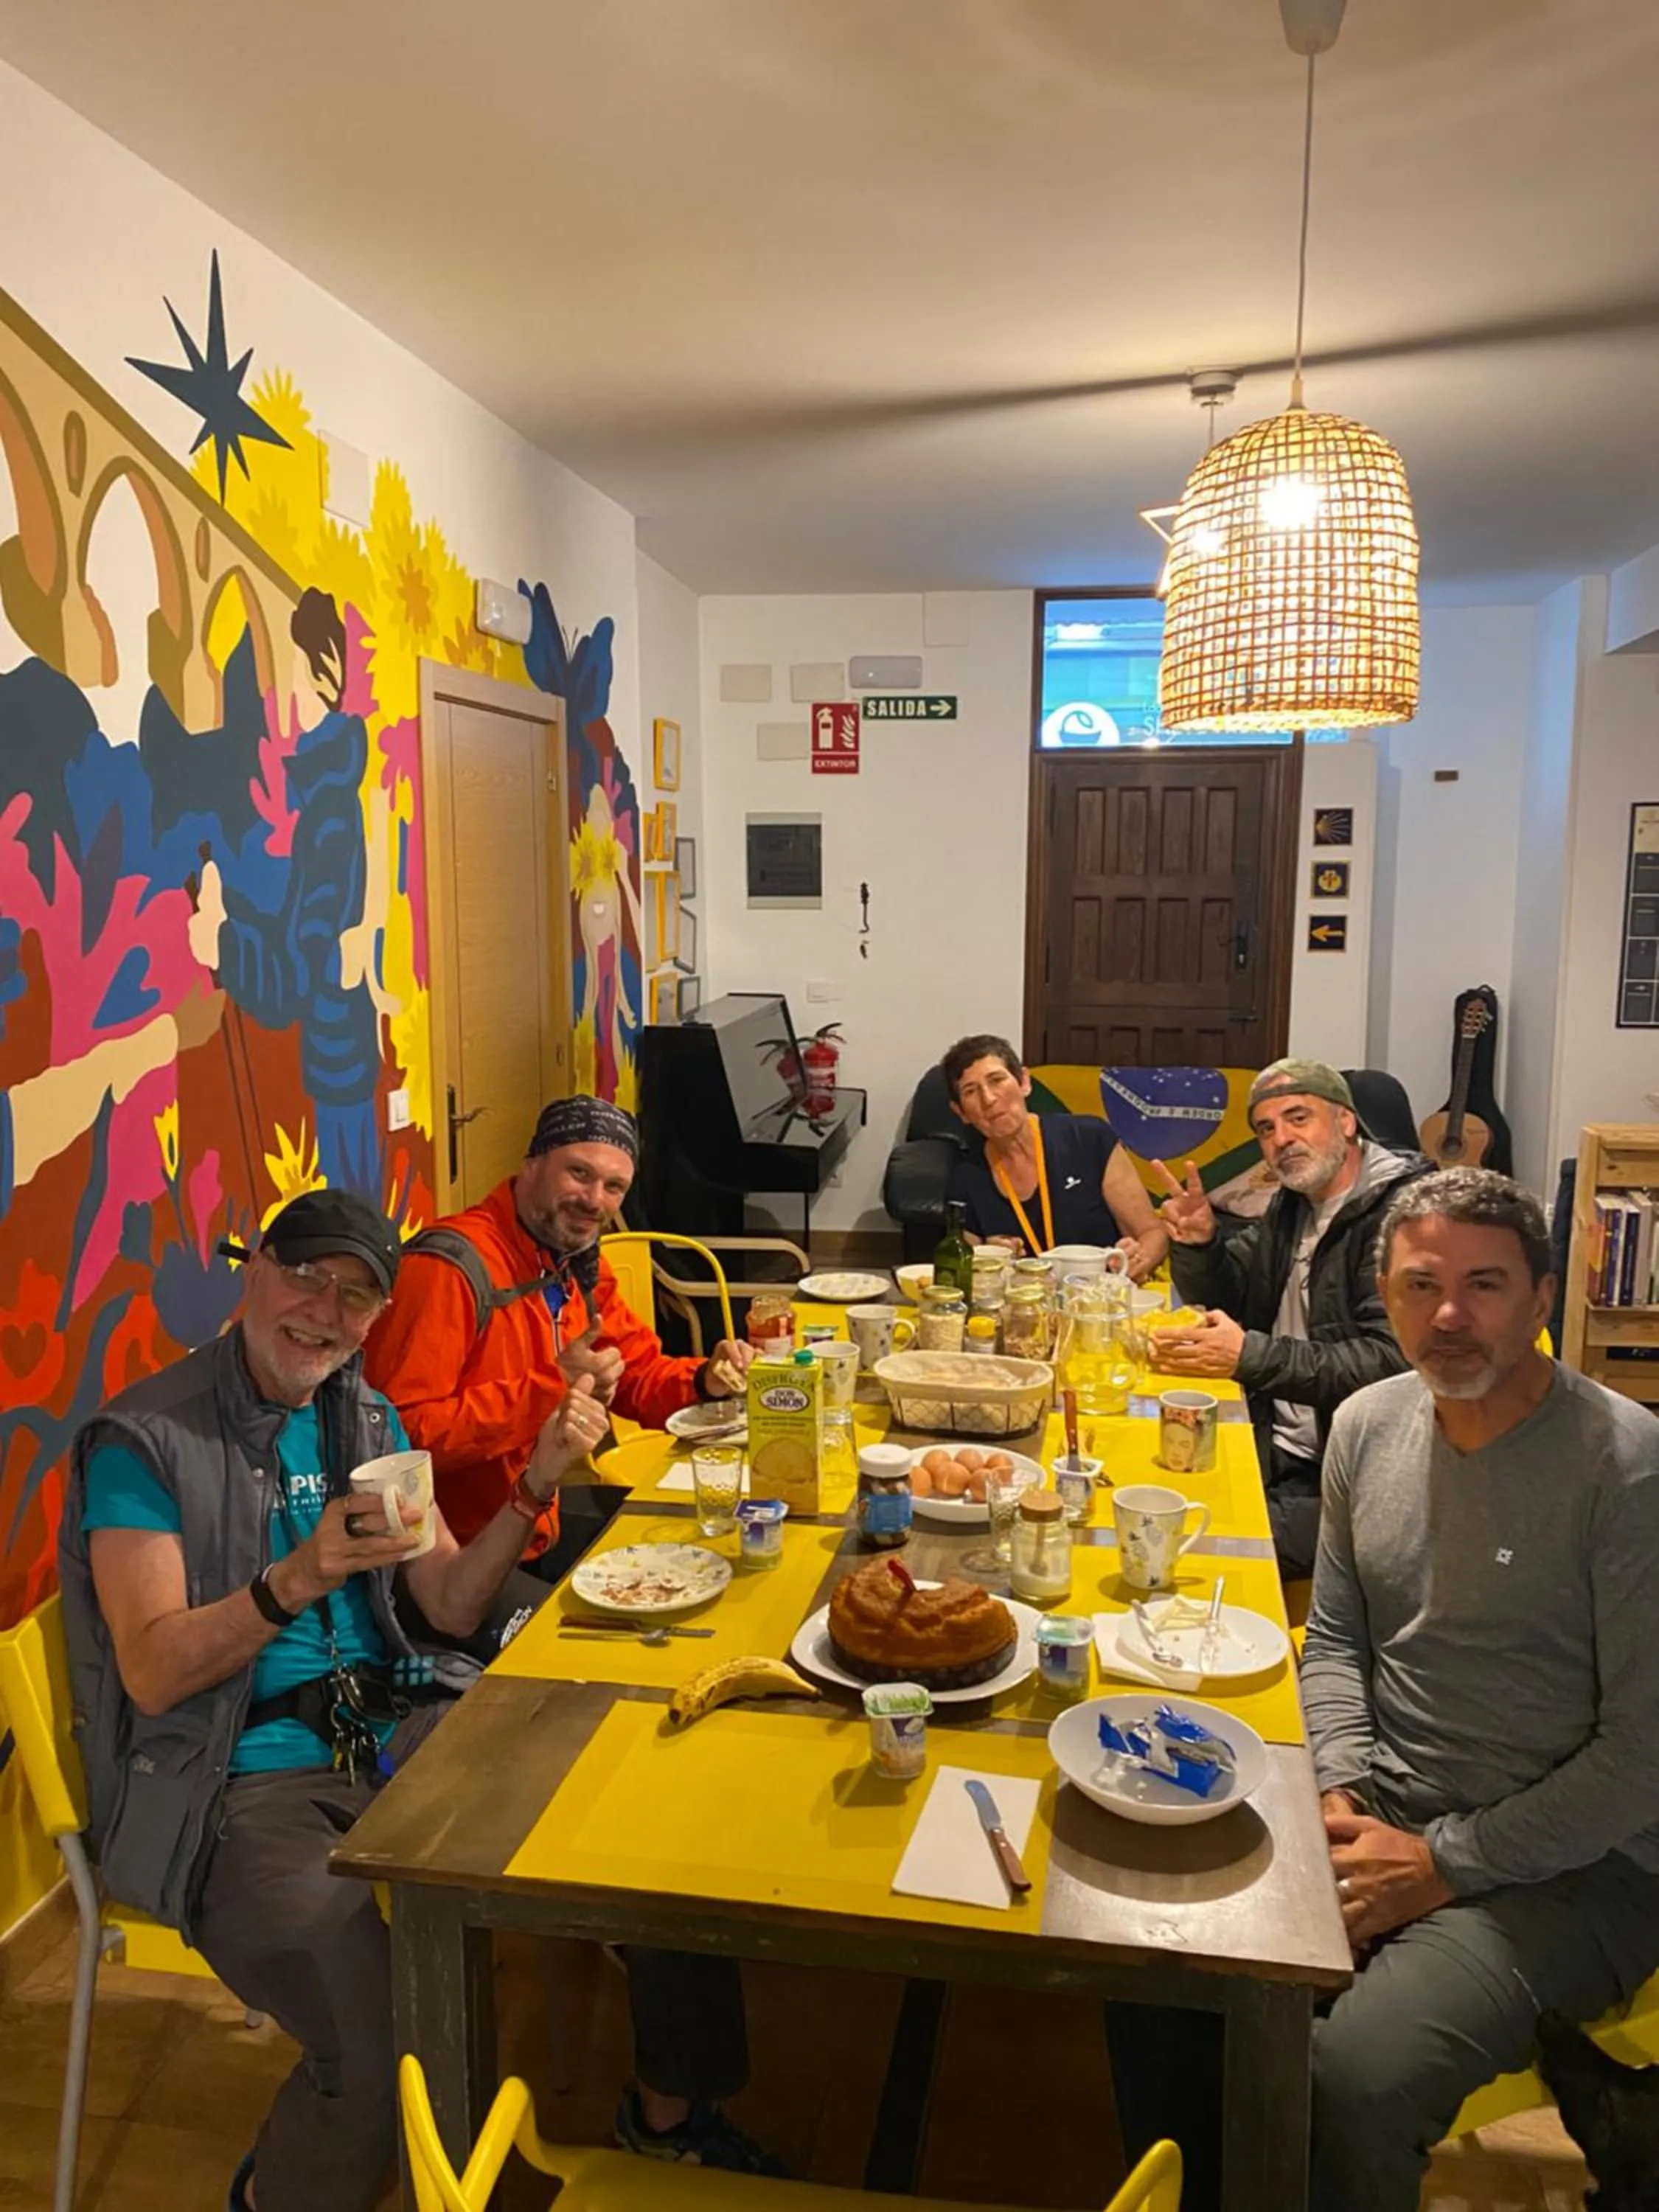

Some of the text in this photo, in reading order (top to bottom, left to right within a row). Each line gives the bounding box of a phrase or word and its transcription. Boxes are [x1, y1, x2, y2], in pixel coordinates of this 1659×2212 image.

[867, 700, 927, 717] SALIDA
[815, 759, 856, 768] EXTINTOR
[775, 1390, 796, 1398] DON
[765, 1397, 804, 1408] SIMON
